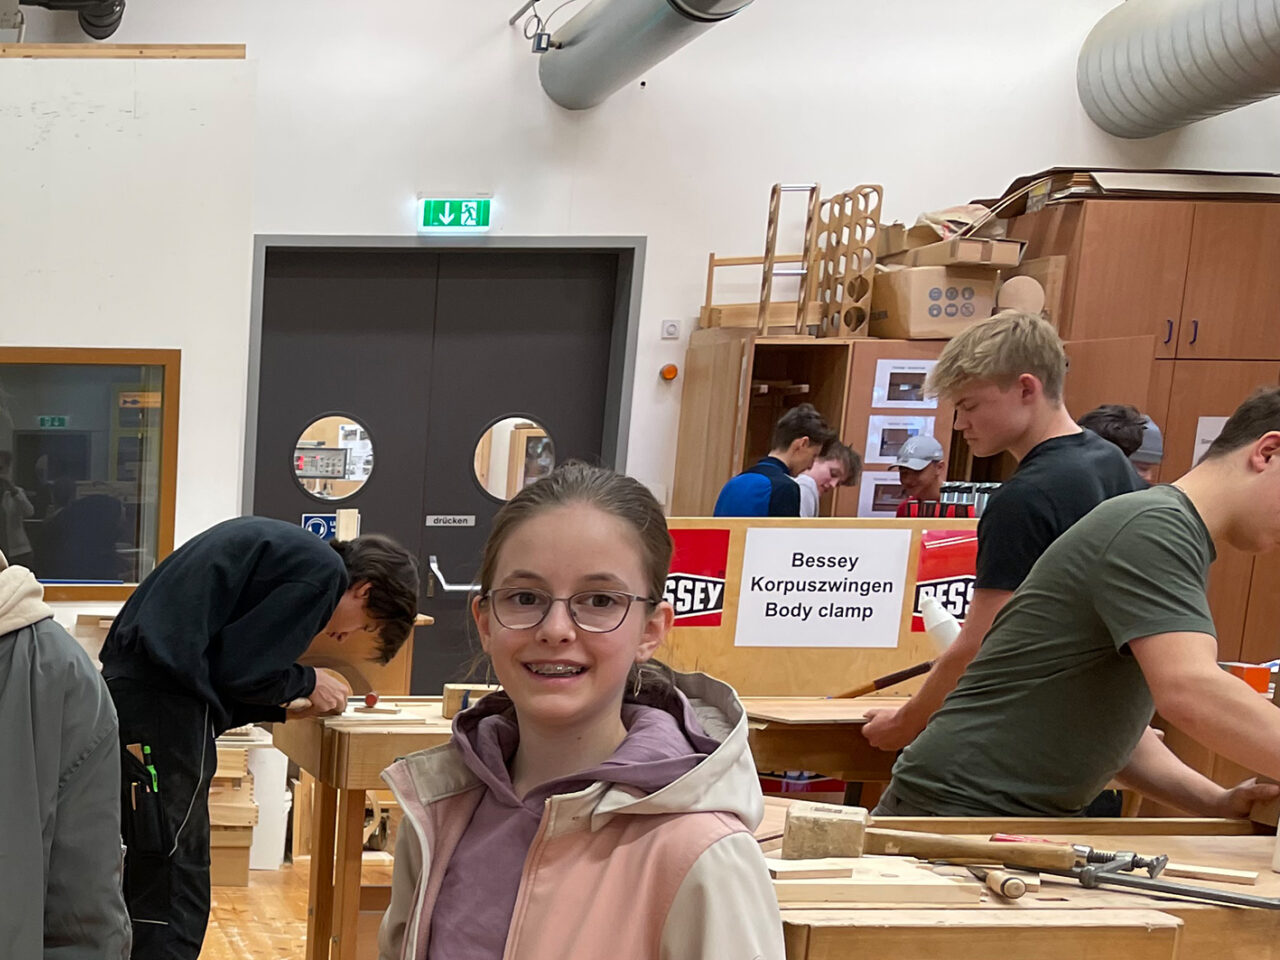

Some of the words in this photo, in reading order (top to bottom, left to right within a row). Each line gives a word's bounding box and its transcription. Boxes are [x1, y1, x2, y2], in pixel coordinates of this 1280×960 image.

[433, 516, 468, 525] drücken
[791, 552, 859, 572] Bessey
[662, 579, 723, 612] SSEY
[750, 576, 894, 597] Korpuszwingen
[765, 602, 813, 621] Body
[818, 603, 874, 622] clamp
